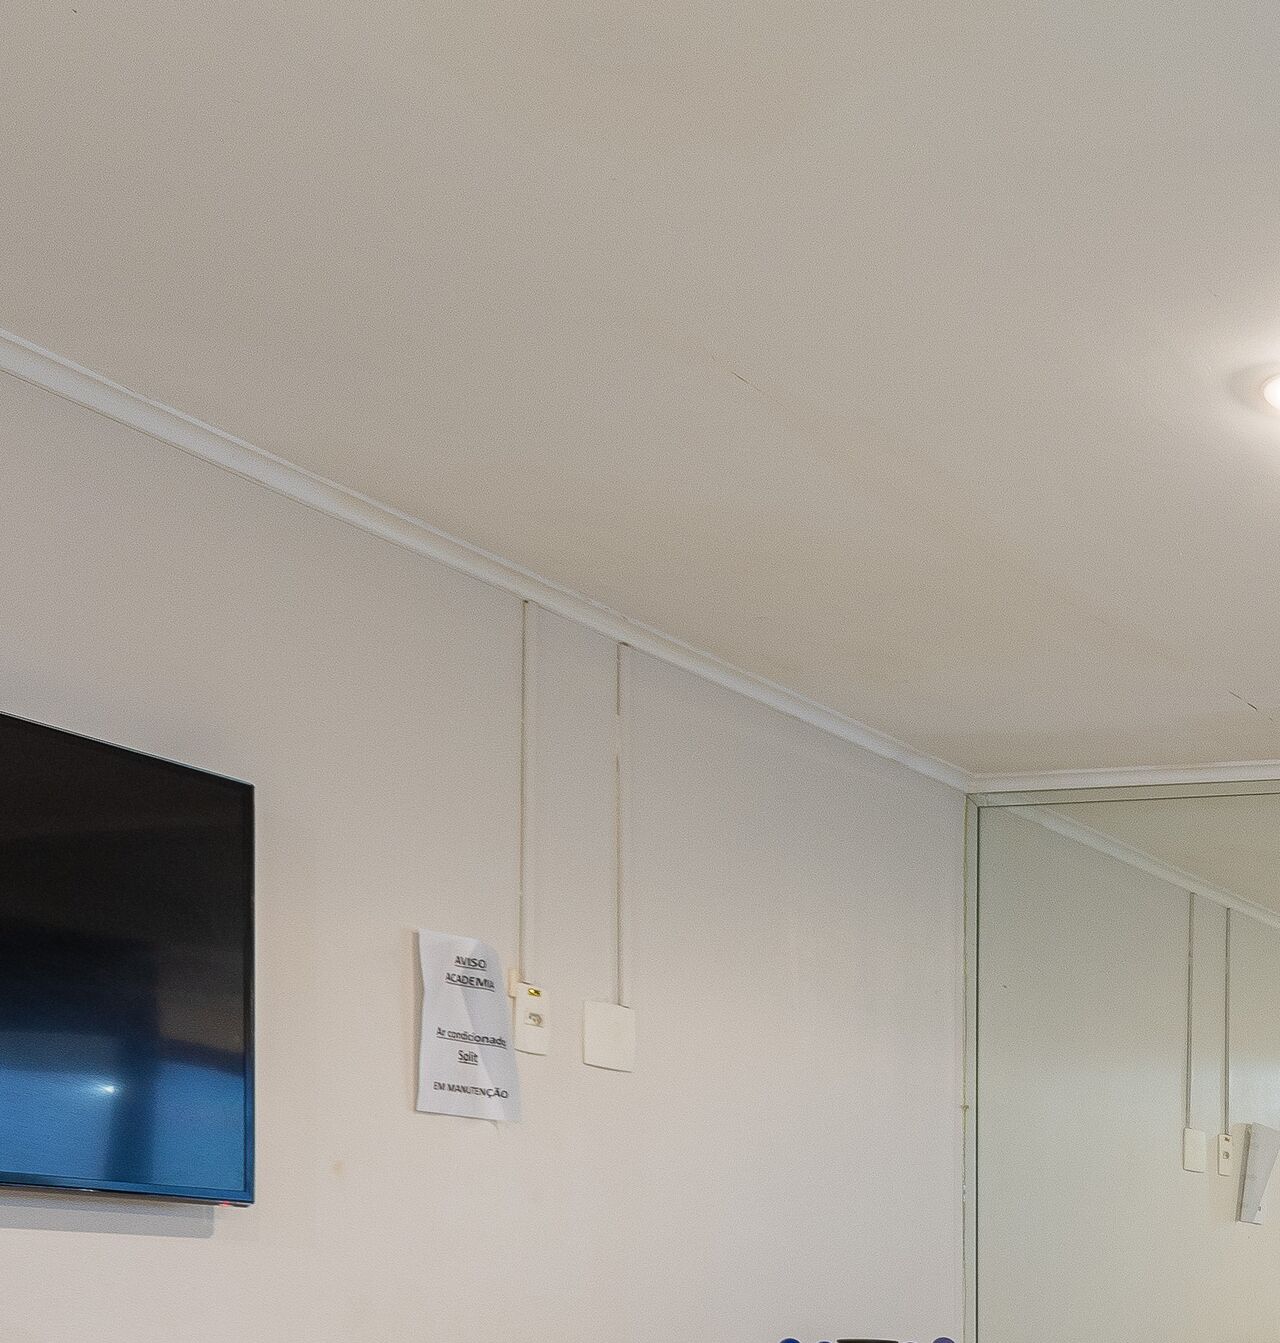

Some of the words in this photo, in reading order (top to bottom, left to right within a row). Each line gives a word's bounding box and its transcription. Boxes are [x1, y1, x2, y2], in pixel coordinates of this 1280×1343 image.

[454, 956, 487, 970] AVISO
[446, 972, 496, 990] ACADEMIA
[436, 1026, 446, 1036] Ar
[447, 1028, 507, 1047] condicionado
[458, 1050, 478, 1063] Split
[434, 1082, 446, 1092] EM
[447, 1084, 509, 1099] MANUTENÇÃO
